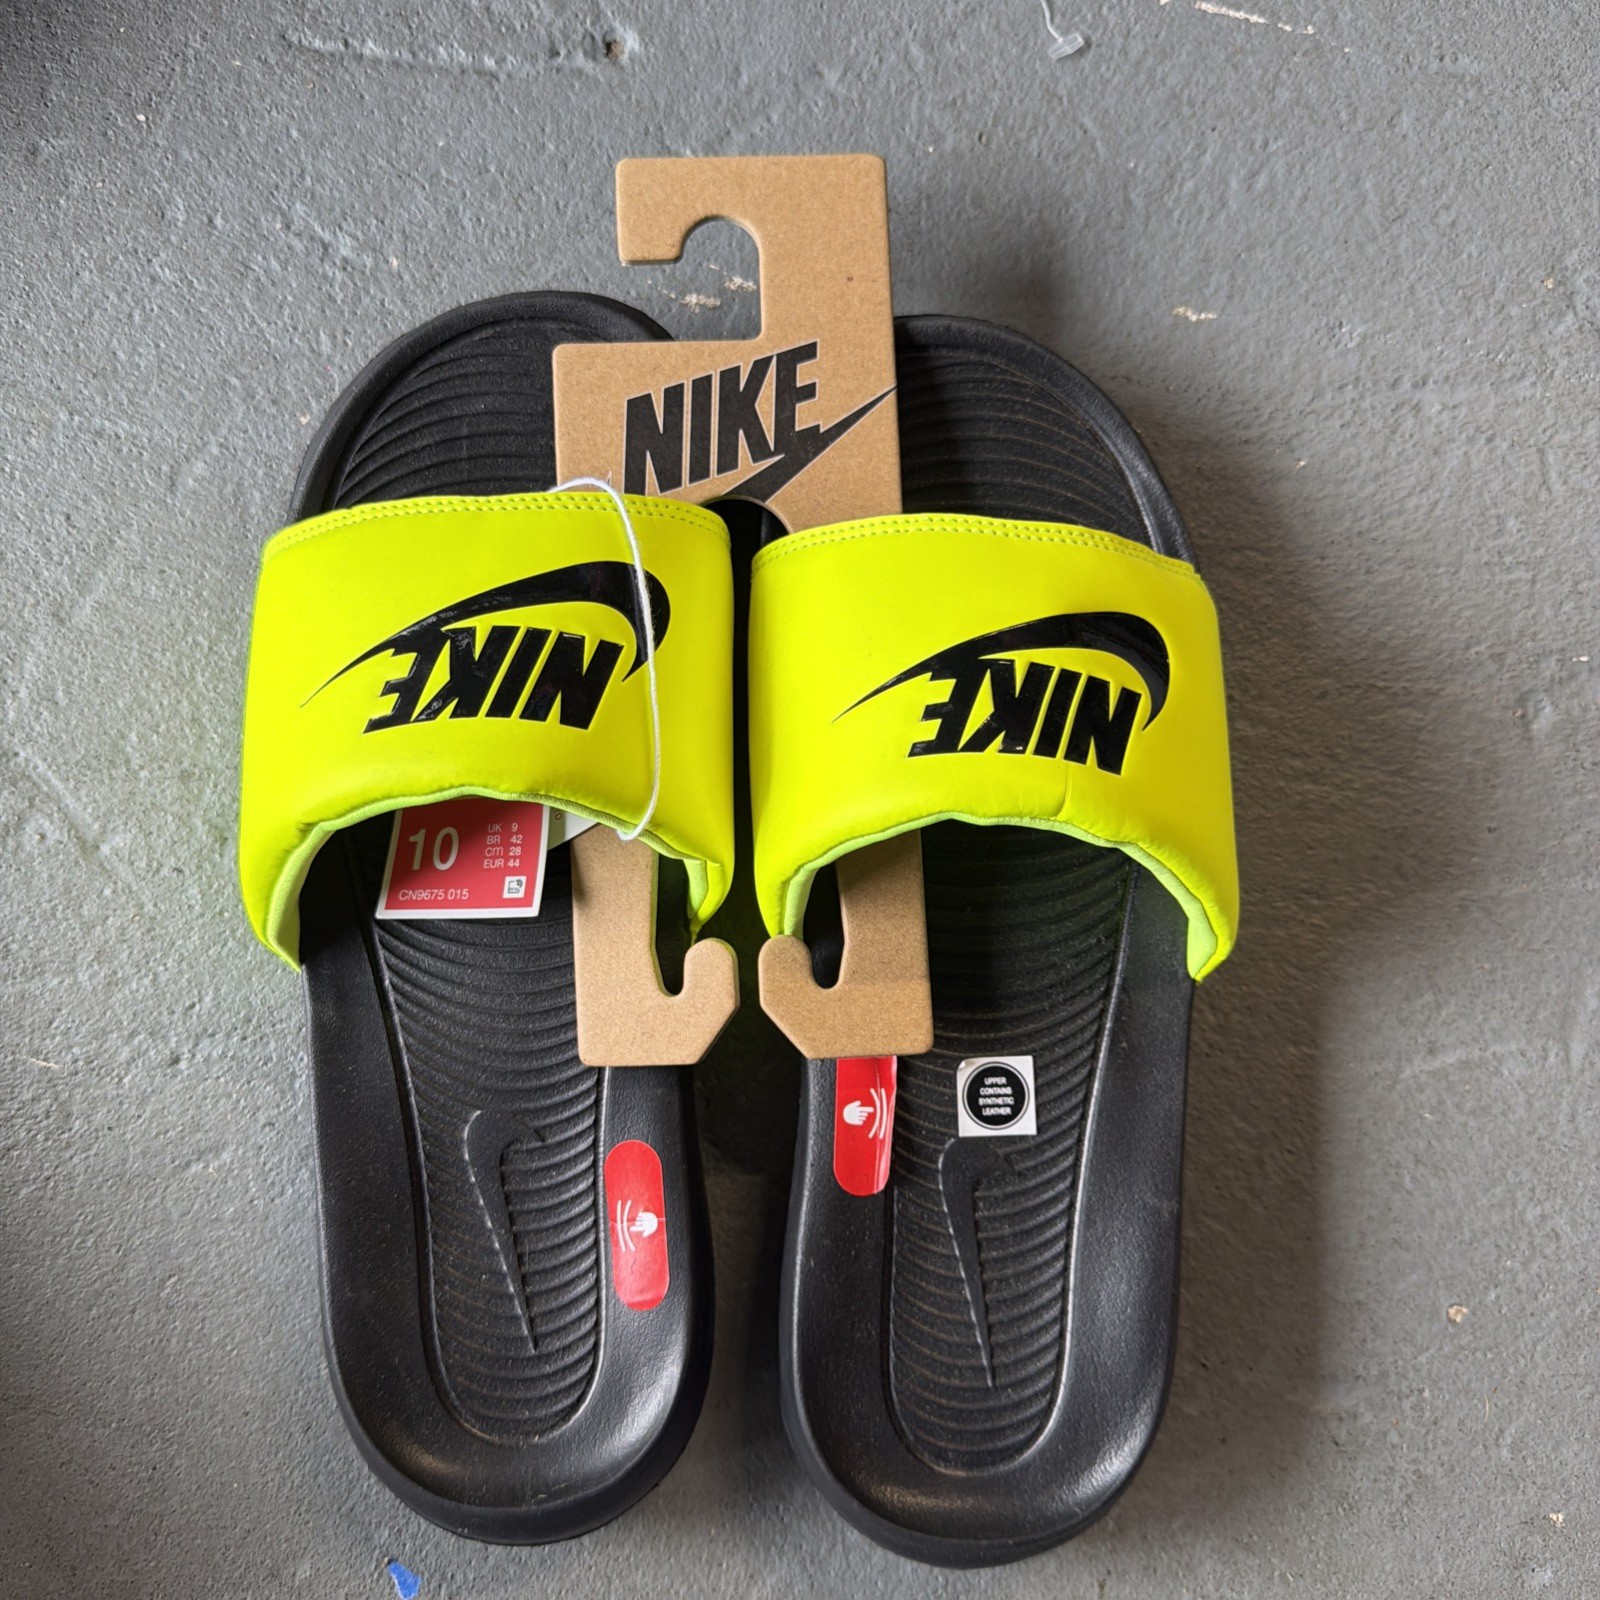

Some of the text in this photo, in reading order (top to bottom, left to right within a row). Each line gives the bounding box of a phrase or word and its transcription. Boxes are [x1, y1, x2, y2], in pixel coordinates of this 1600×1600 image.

[623, 340, 821, 497] NIKE
[362, 624, 625, 734] NIKE
[907, 658, 1143, 776] NIKE
[488, 822, 519, 833] UK 9
[486, 834, 523, 845] BR 42
[408, 827, 460, 871] 10
[509, 846, 522, 856] 28
[483, 858, 520, 869] EUR 44
[399, 888, 469, 901] CN9675 015
[984, 1077, 1007, 1085] UPPER
[979, 1087, 1012, 1095] CONTAINS
[978, 1097, 1014, 1105] SYNTHETIC
[982, 1107, 1012, 1116] LEATHER
